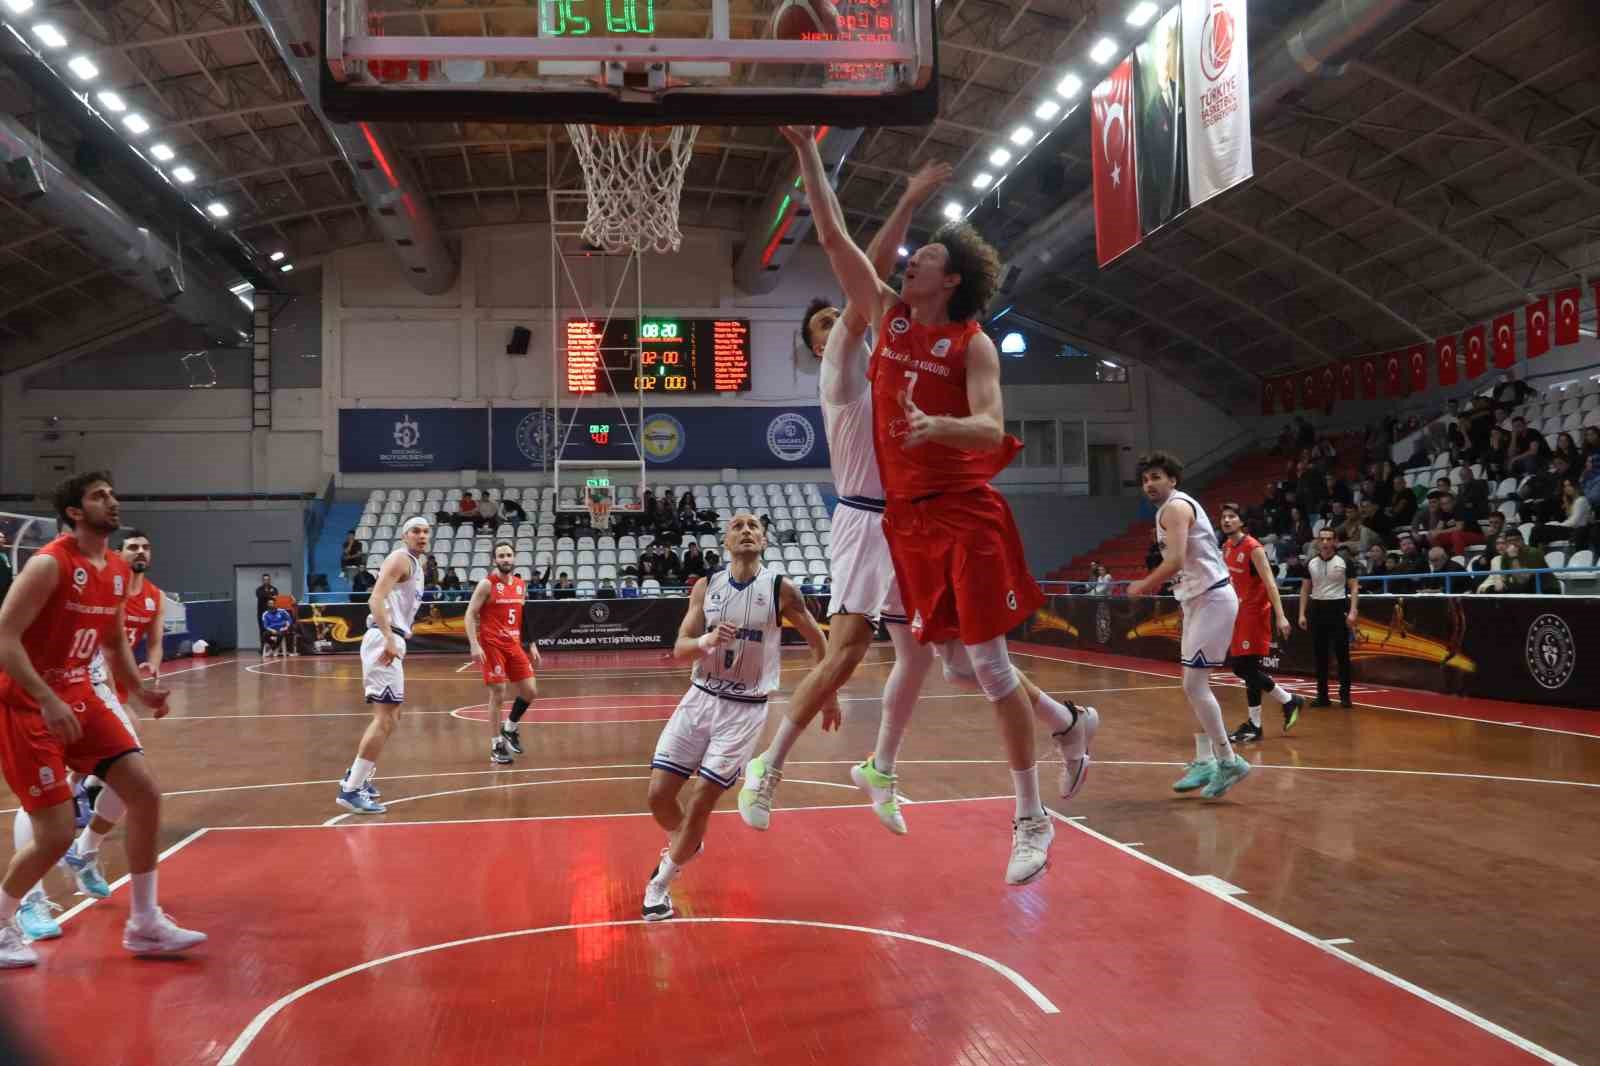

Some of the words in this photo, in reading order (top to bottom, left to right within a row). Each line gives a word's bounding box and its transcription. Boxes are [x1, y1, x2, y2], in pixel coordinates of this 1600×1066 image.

[660, 323, 677, 338] 20
[904, 370, 919, 402] 7
[507, 609, 516, 625] 5
[68, 627, 97, 660] 10
[538, 638, 557, 646] DEV
